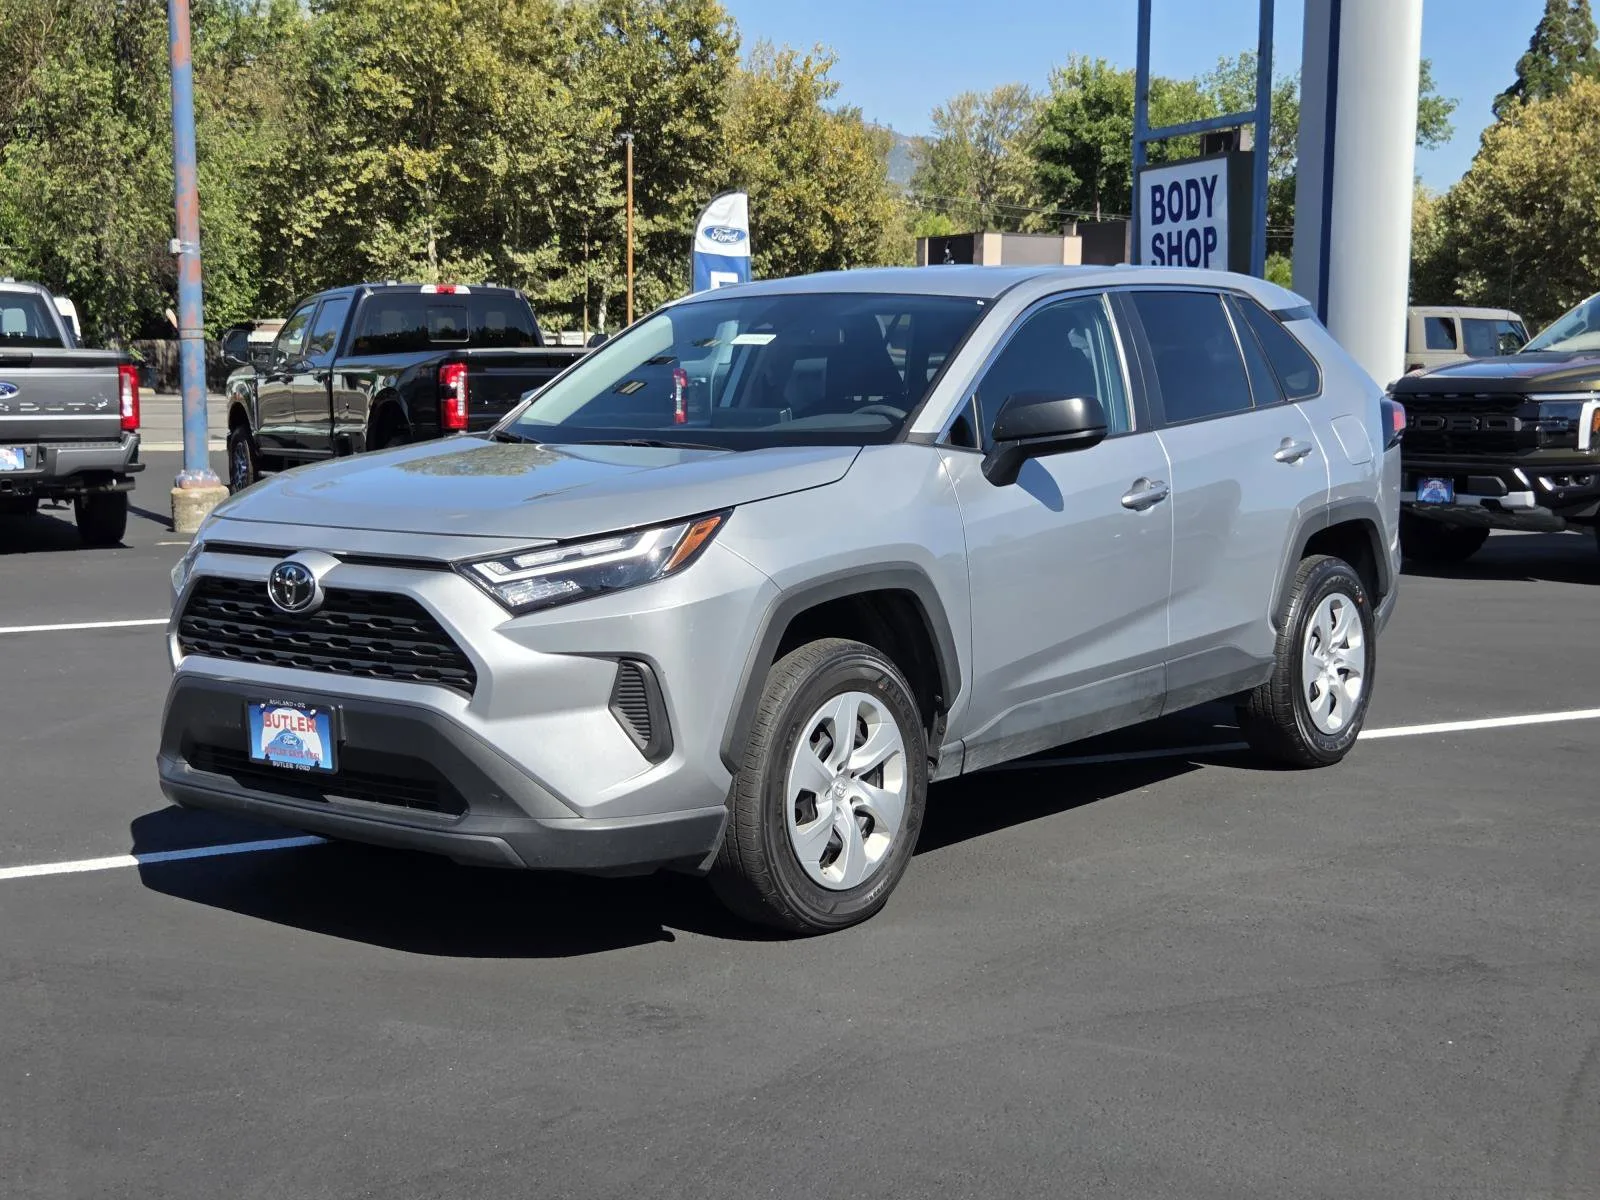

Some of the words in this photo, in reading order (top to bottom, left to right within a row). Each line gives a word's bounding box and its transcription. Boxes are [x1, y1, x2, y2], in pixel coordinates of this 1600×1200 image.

[1151, 174, 1218, 226] BODY
[711, 228, 739, 242] Ford
[1151, 226, 1218, 269] SHOP
[1408, 415, 1522, 432] ORD
[263, 711, 316, 733] BUTLER
[272, 761, 294, 769] BUTLER
[295, 763, 311, 772] FORD
